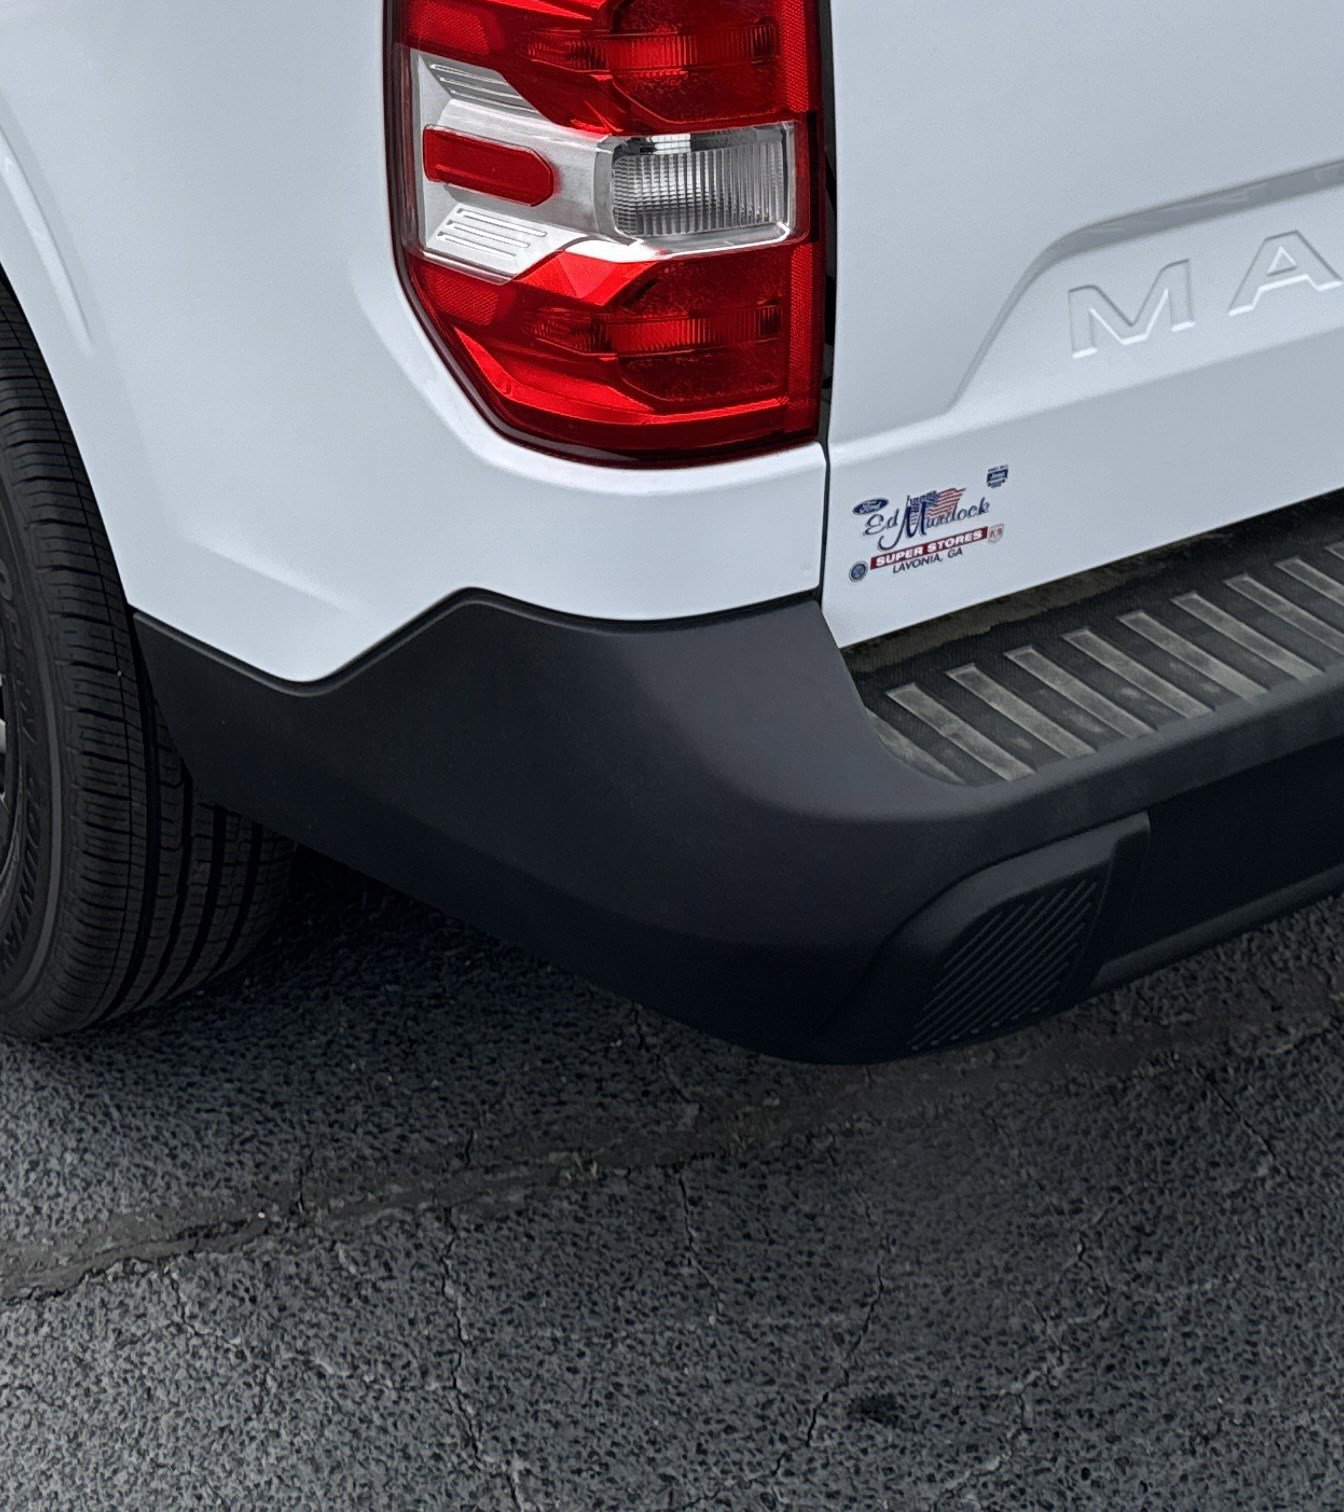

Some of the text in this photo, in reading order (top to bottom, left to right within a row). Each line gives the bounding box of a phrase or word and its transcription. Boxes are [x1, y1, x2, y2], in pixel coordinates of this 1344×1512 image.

[862, 496, 991, 551] Ed Murdock
[875, 529, 983, 567] SUPER STORES
[892, 547, 963, 574] LAVONIA, GA
